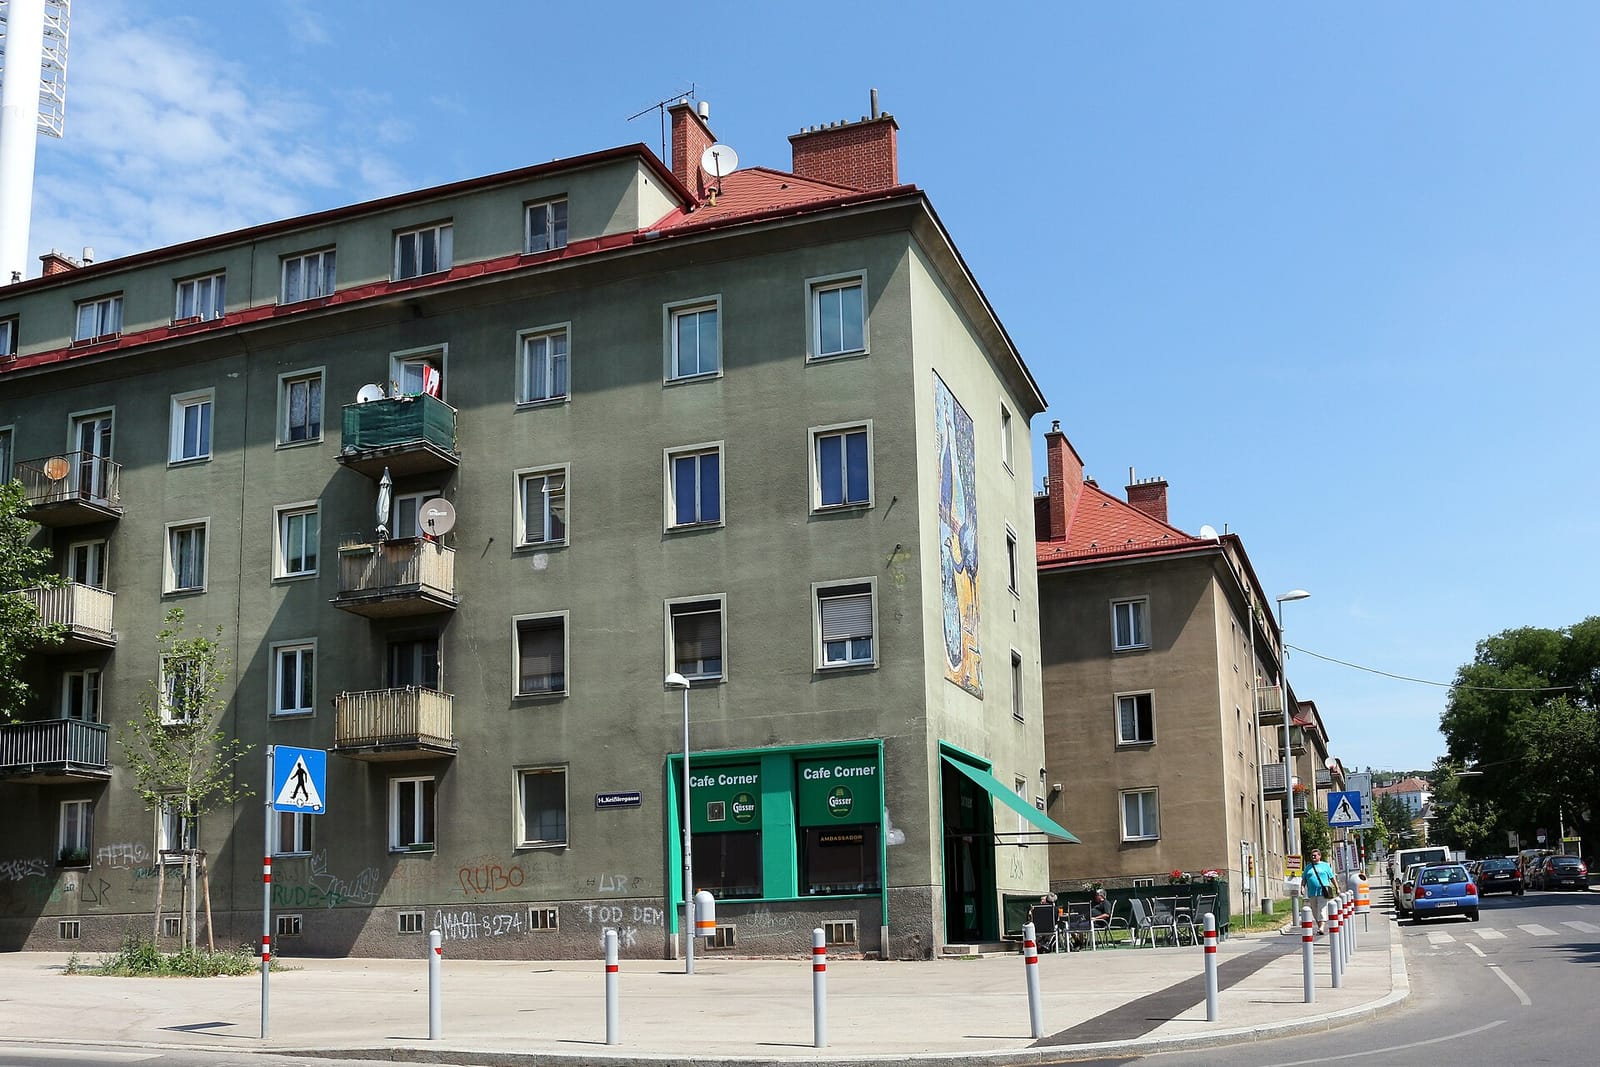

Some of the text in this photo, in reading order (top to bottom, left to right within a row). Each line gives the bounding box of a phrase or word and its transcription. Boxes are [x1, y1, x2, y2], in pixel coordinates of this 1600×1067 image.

[804, 766, 875, 780] Cafe Corner
[689, 774, 758, 787] Cafe Corner
[820, 834, 863, 842] AMBASSADOR
[459, 866, 524, 894] RUBO
[584, 905, 664, 926] TOD DEM
